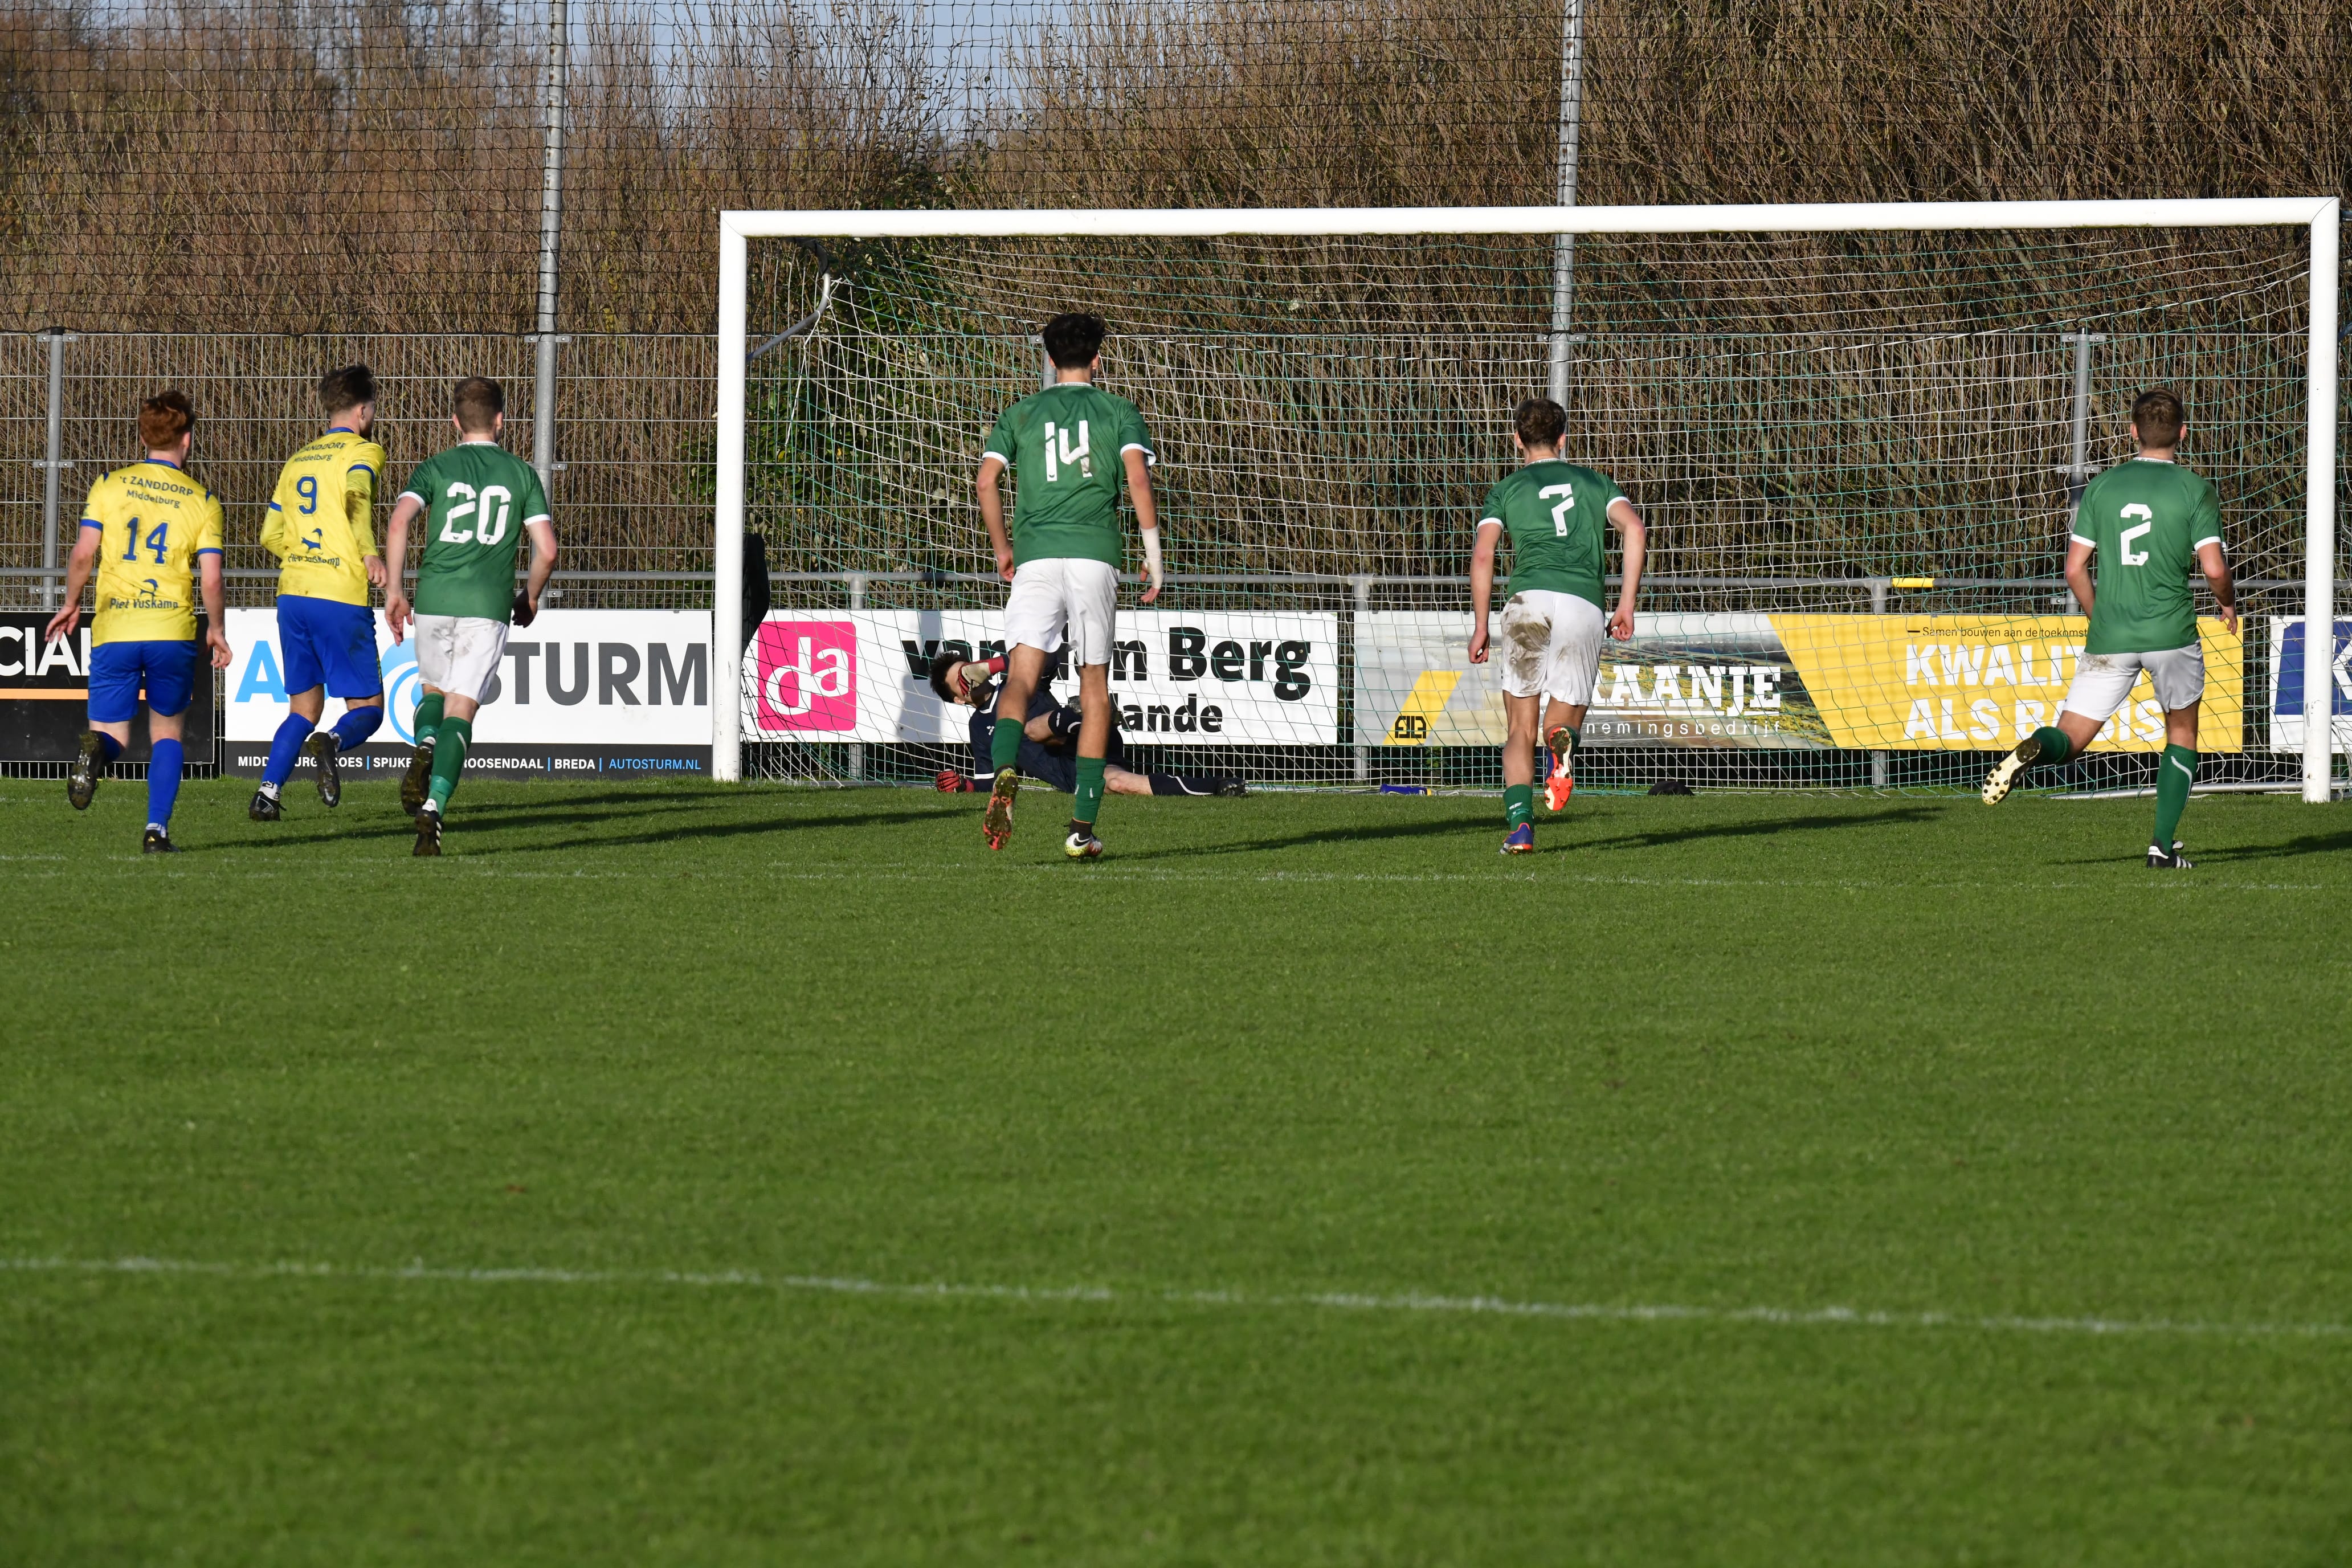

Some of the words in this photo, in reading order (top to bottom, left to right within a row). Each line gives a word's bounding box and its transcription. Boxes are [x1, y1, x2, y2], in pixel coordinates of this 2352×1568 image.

[300, 442, 346, 453] ANDDORP
[1044, 420, 1093, 482] 14
[126, 489, 181, 509] Middelburg
[130, 476, 194, 496] ZANDDORP
[296, 475, 318, 516] 9
[439, 482, 512, 545] 20
[1538, 483, 1575, 536] 7
[121, 516, 169, 565] 14
[2120, 503, 2153, 566] 2
[109, 598, 130, 610] Piet
[1922, 627, 1957, 636] Samen
[1961, 627, 2000, 637] bouwen
[2004, 628, 2022, 637] aan
[2025, 627, 2038, 637] de
[2041, 627, 2088, 638] toekomst
[765, 636, 849, 715] da
[1169, 626, 1311, 701] Berg
[1903, 699, 2000, 740] ALS
[335, 757, 363, 767] OES
[554, 758, 595, 769] BREDA
[609, 758, 701, 770] AUTOSTURM.NL
